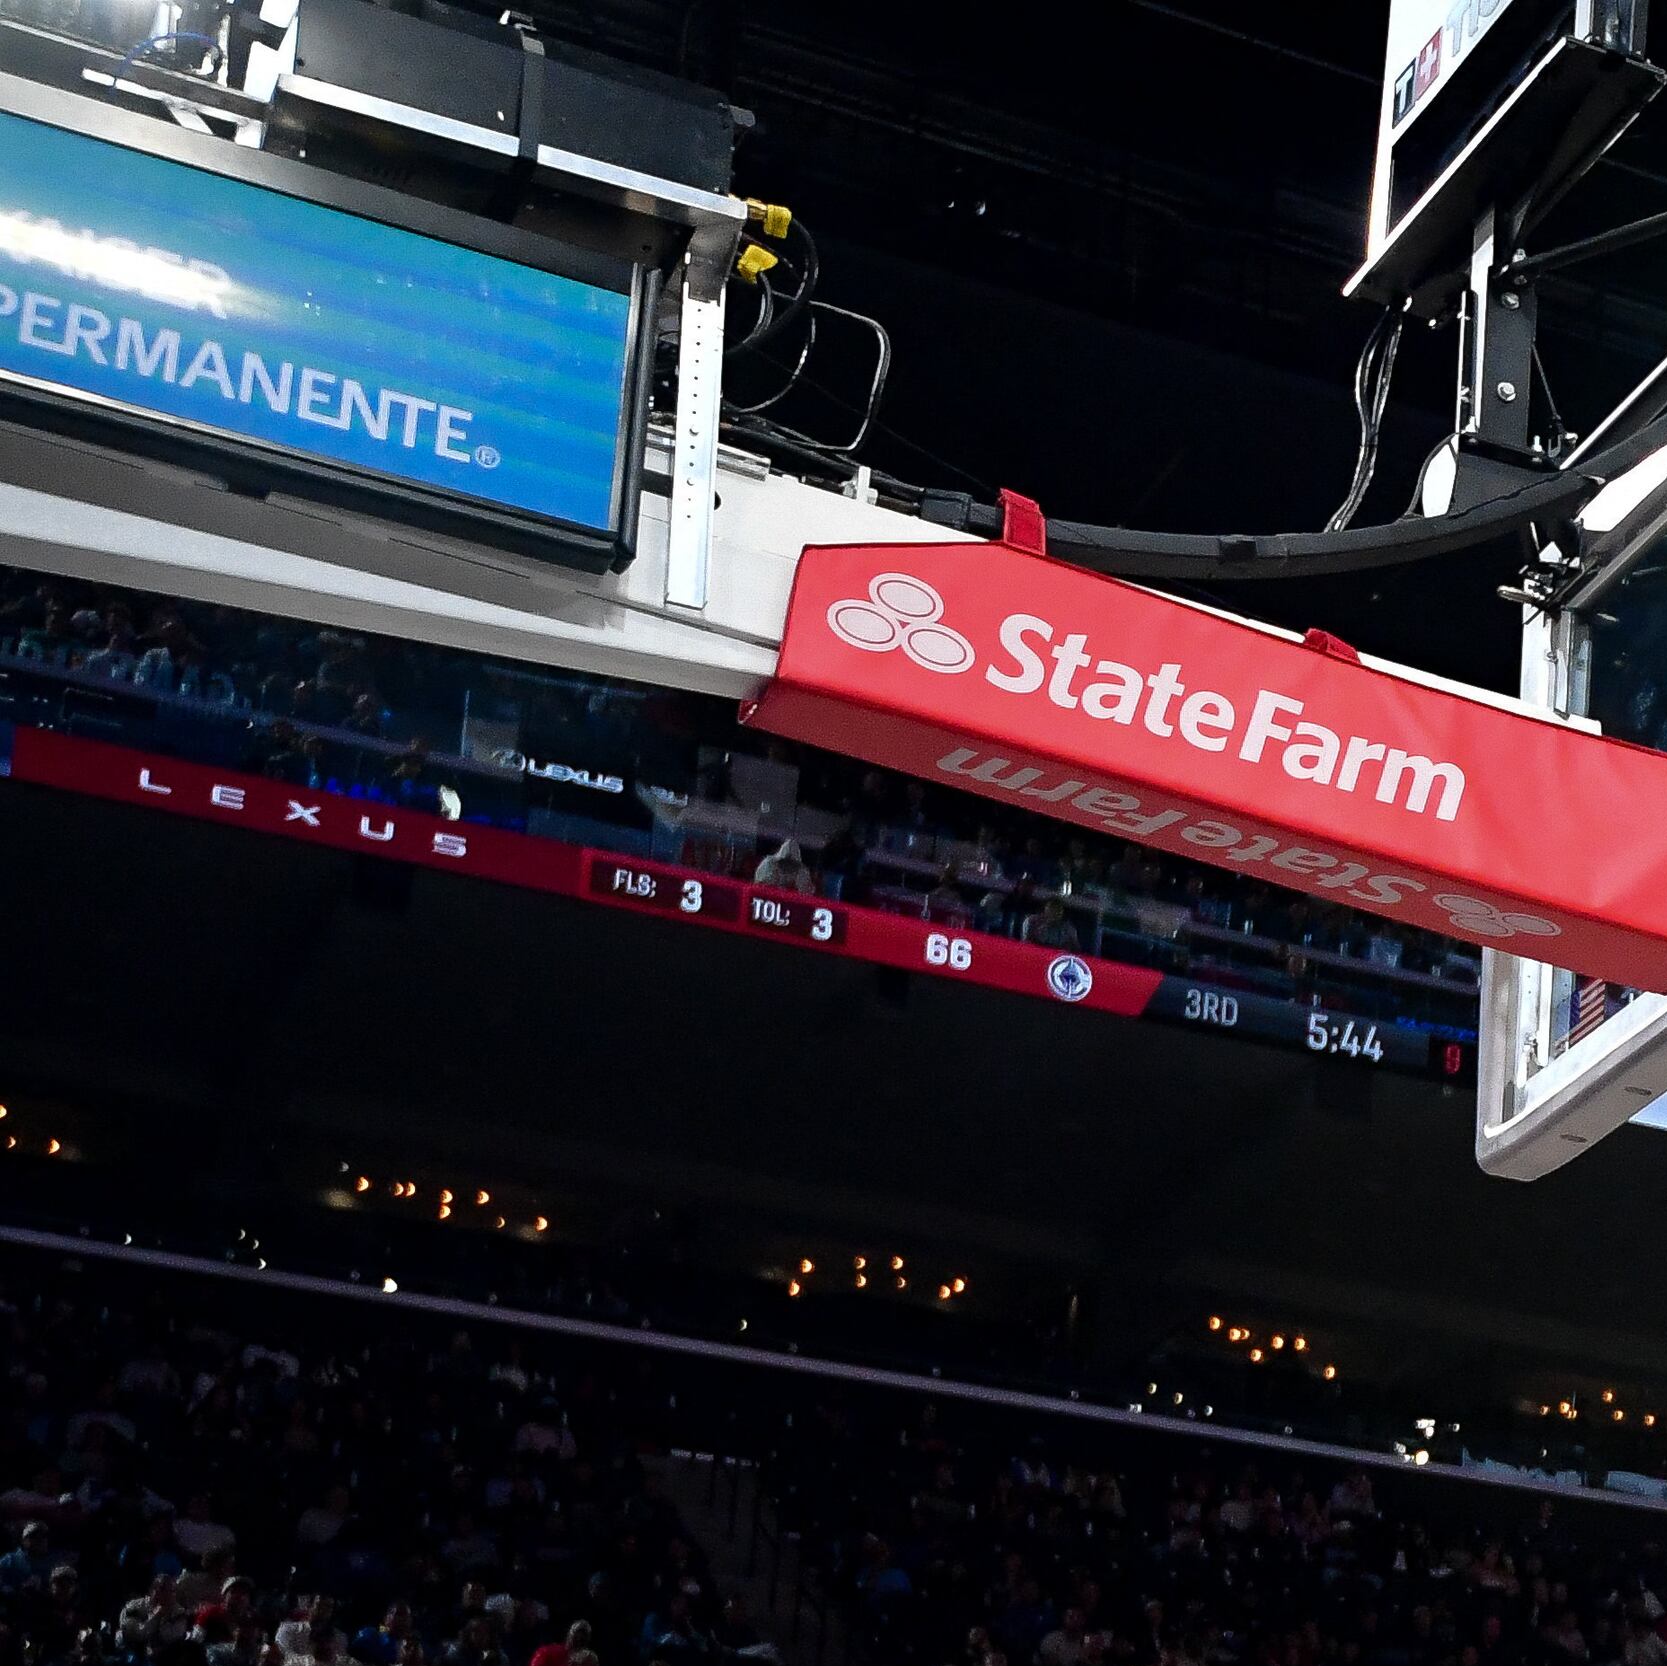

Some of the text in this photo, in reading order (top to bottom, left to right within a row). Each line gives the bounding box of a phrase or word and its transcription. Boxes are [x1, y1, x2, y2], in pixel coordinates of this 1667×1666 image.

[985, 613, 1467, 822] State Farm
[528, 758, 625, 793] LEXUS
[139, 767, 467, 857] LEXUS
[680, 879, 704, 913] 3
[811, 908, 834, 941] 3
[926, 933, 973, 970] 66
[1185, 988, 1239, 1027] 3RD
[1308, 1012, 1384, 1063] 5:44
